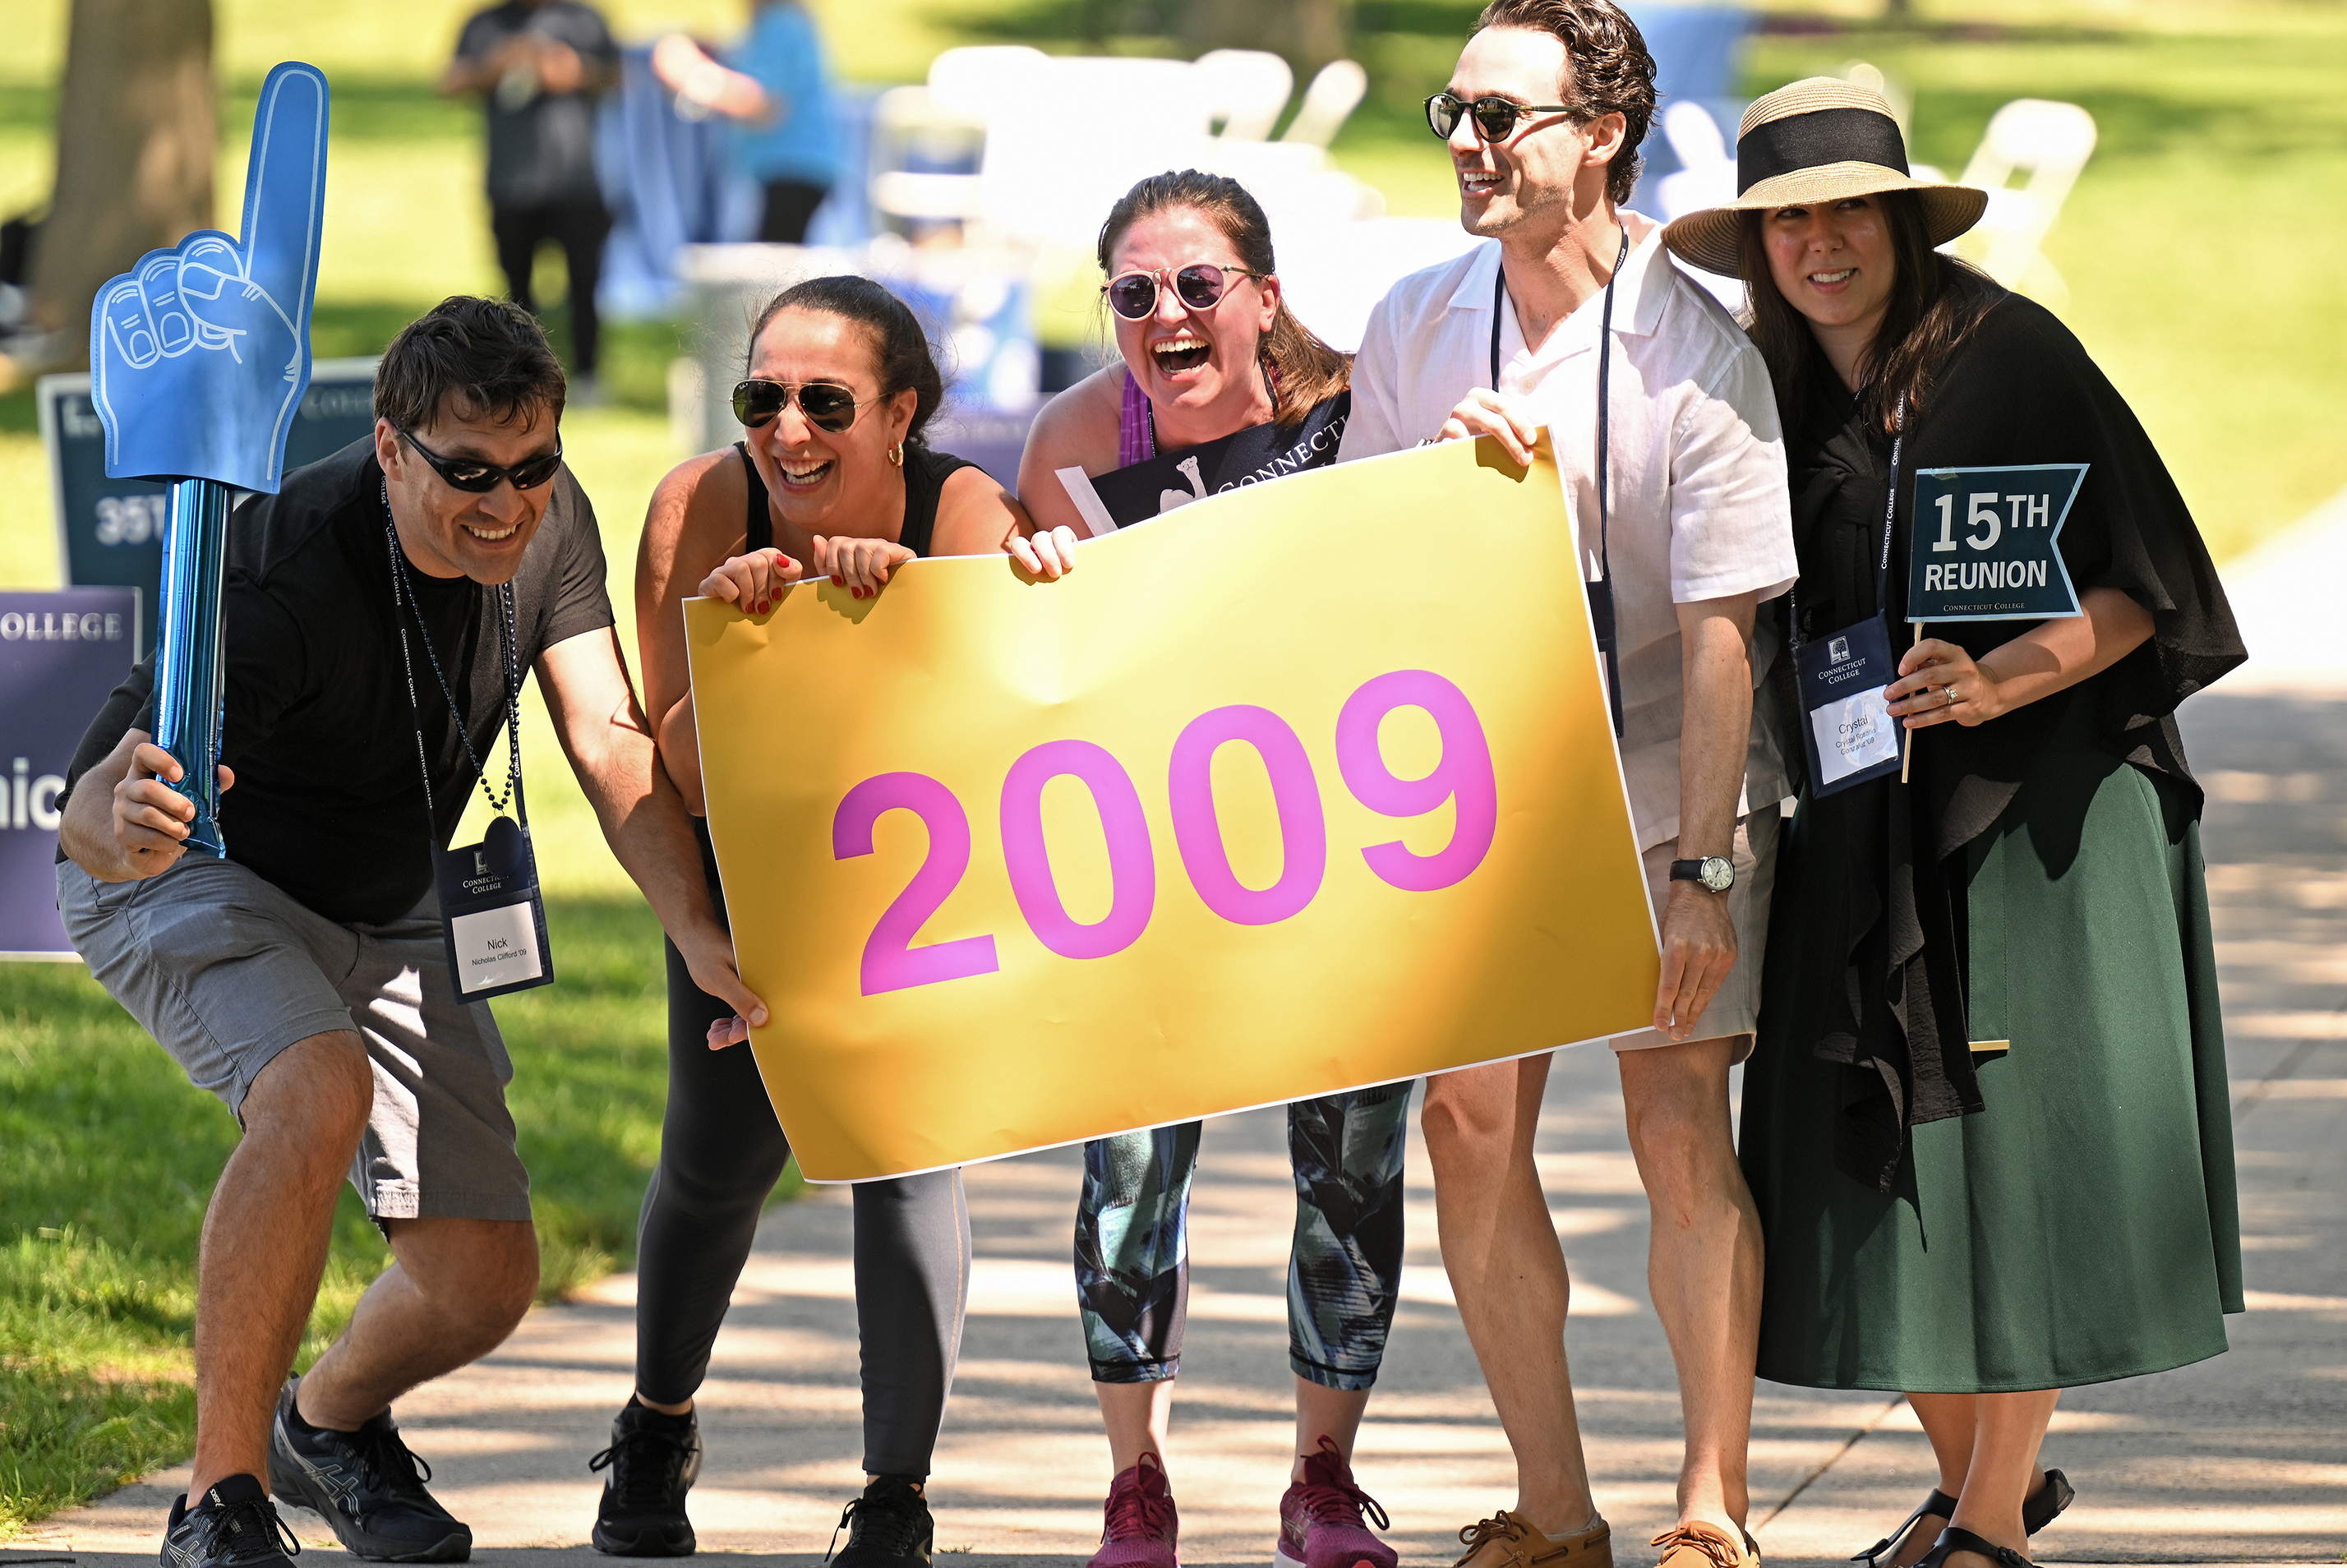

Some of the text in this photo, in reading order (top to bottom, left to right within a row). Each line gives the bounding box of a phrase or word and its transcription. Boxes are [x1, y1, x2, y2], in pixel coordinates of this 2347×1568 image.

[1881, 488, 1895, 570] CONNECTICUT COLLEGE
[1932, 491, 2050, 552] 15TH
[1925, 560, 2047, 591] REUNION
[393, 576, 402, 606] COLLEGE
[1943, 602, 2026, 612] CONNECTICUT COLLEGE
[401, 628, 417, 708] CONNECTICUT COLLEGE
[1818, 657, 1866, 680] CONNECTICUT
[1828, 669, 1861, 685] COLLEGE
[1838, 714, 1869, 734] Crystal
[417, 730, 428, 778] CONNECTICUT
[1835, 736, 1856, 749] Crystal
[832, 668, 1497, 997] 2009
[472, 882, 501, 894] COLLEGE
[487, 938, 508, 950] Nick
[472, 948, 528, 966] Nicholas Clifford '09
